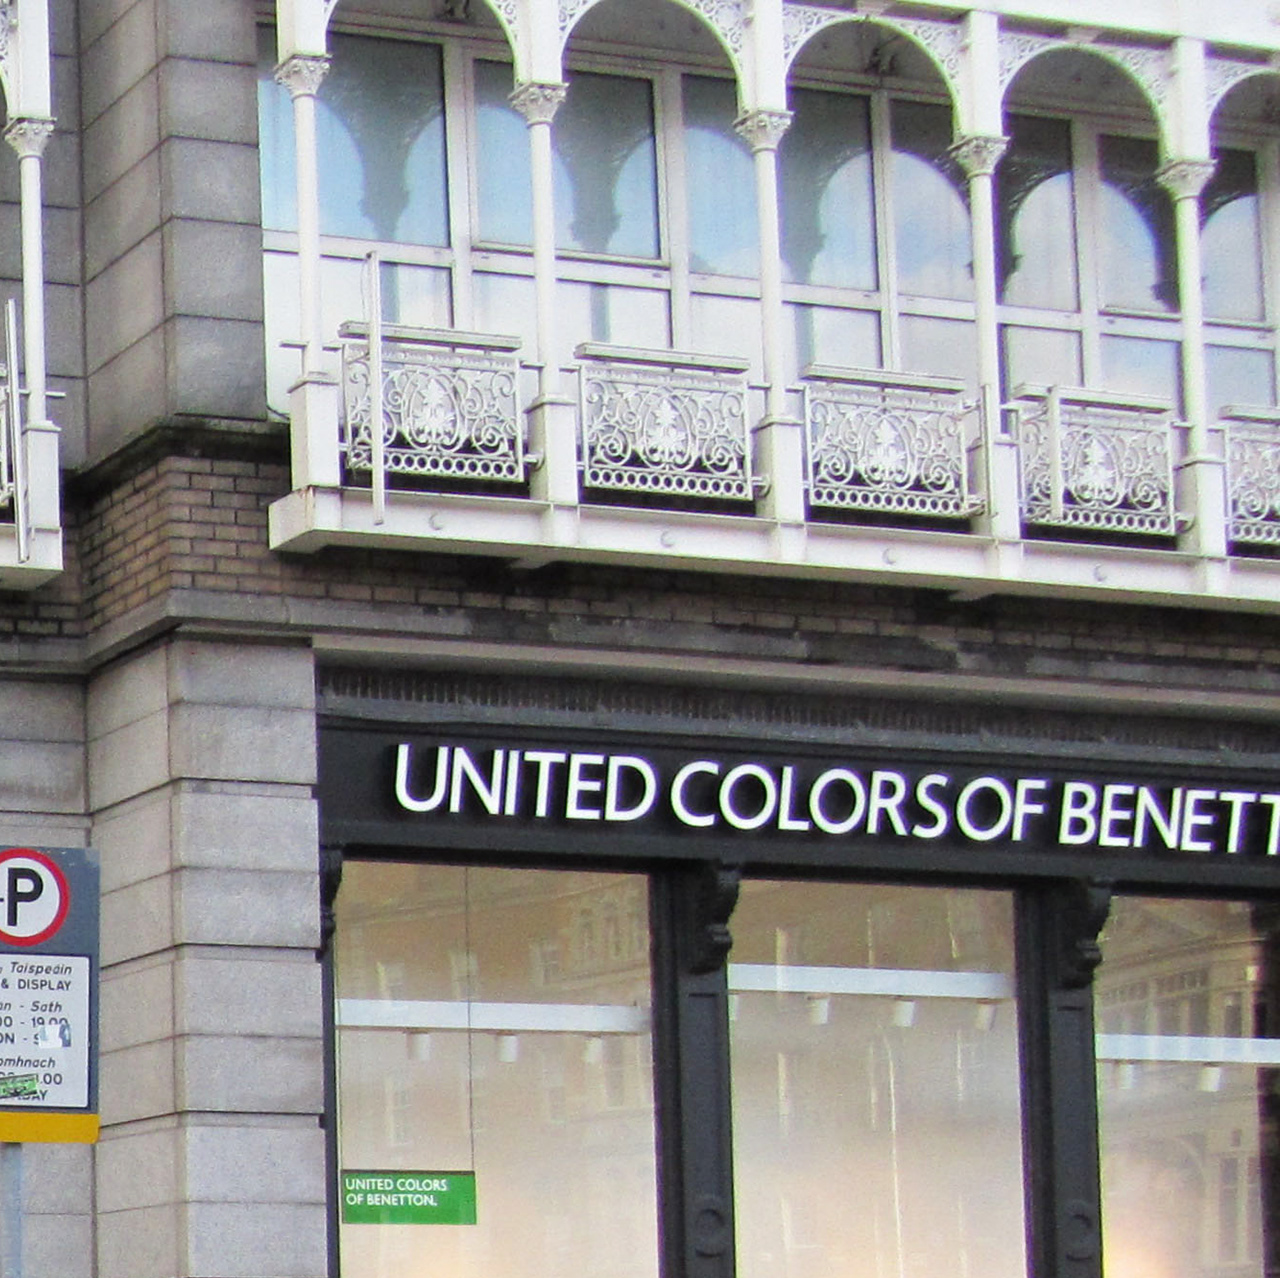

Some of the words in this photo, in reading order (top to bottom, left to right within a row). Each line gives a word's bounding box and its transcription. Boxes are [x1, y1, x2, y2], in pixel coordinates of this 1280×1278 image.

[395, 743, 657, 822] UNITED
[670, 760, 951, 840] COLORS
[956, 776, 1047, 843] OF
[7, 867, 44, 927] P
[0, 978, 10, 989] &
[17, 978, 72, 991] DISPLAY
[30, 1000, 63, 1013] Sath
[345, 1178, 394, 1191] UNITED
[396, 1178, 448, 1192] COLORS
[346, 1193, 365, 1206] OF
